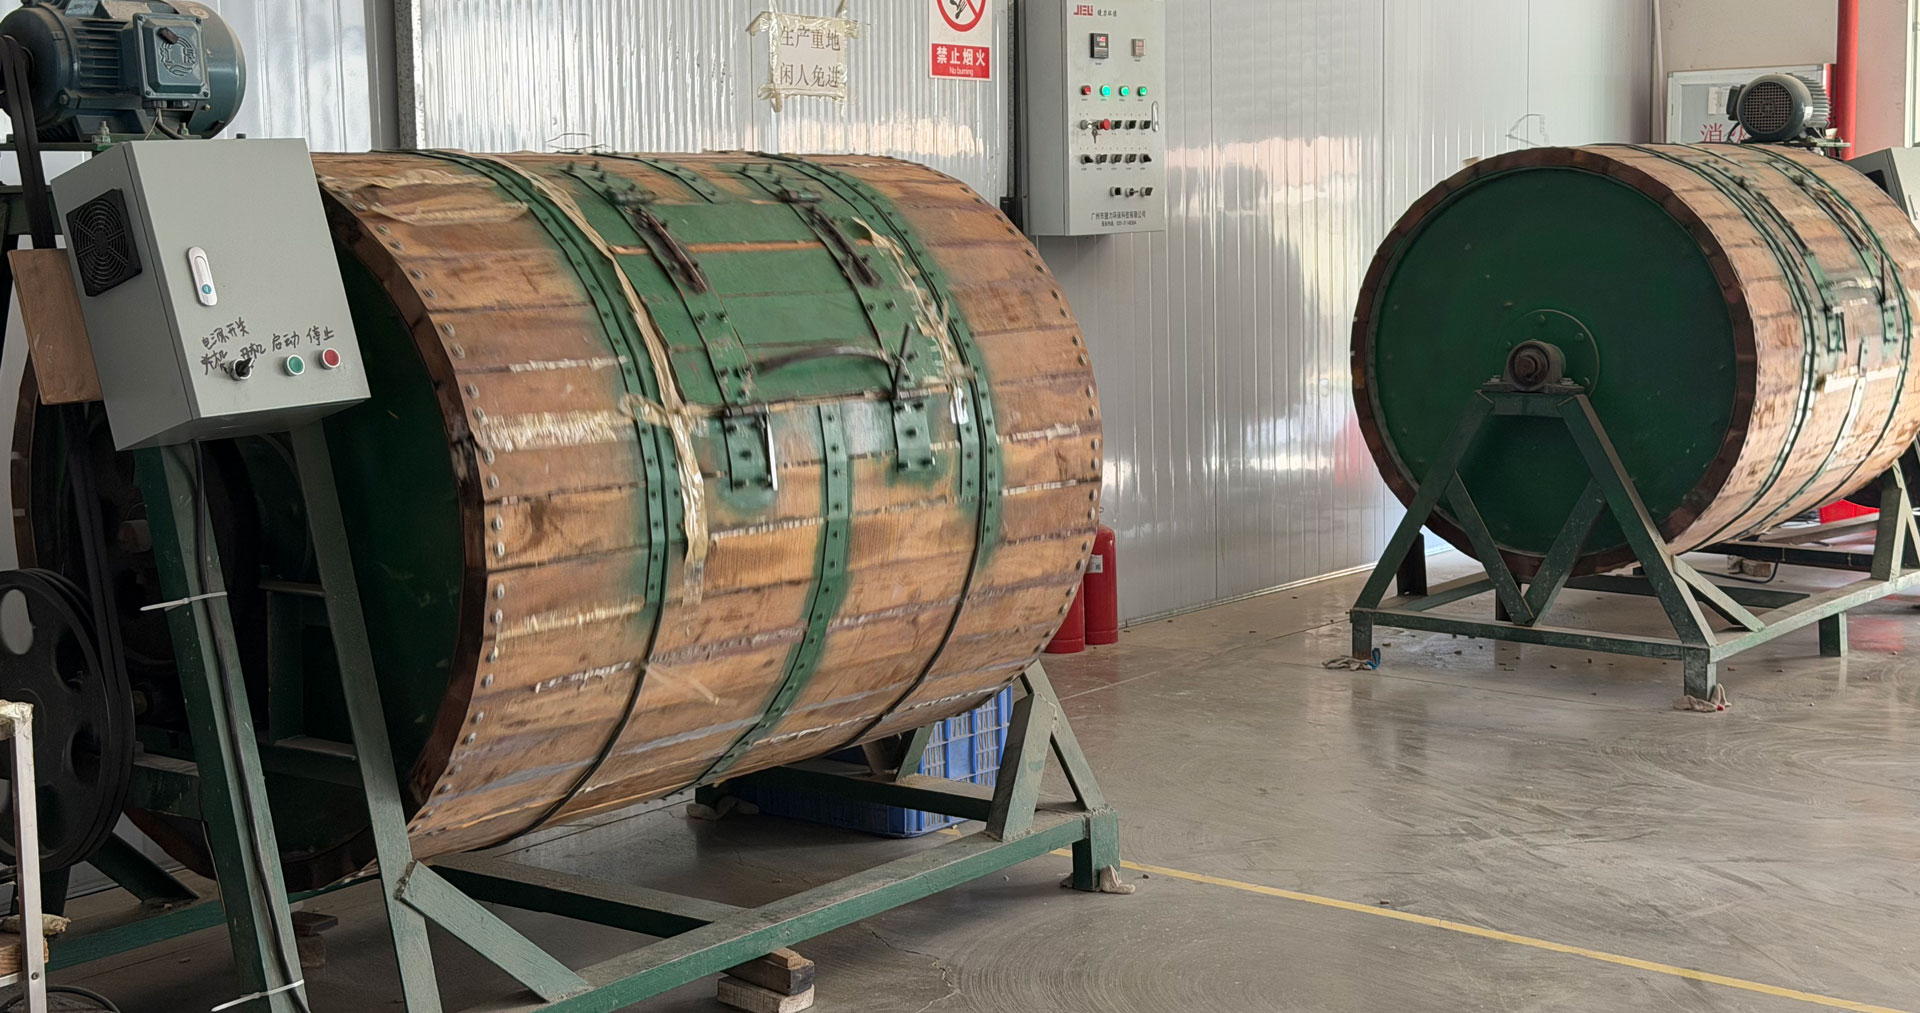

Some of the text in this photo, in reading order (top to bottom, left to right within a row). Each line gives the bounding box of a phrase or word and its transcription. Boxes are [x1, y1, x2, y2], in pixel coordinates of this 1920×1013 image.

[780, 25, 841, 51] 生产重地
[936, 46, 986, 67] 禁止烟火
[780, 62, 841, 88] 闲人免进
[949, 66, 957, 75] No
[201, 316, 250, 350] 电源开关
[271, 330, 301, 352] 启动
[305, 325, 335, 346] 停止
